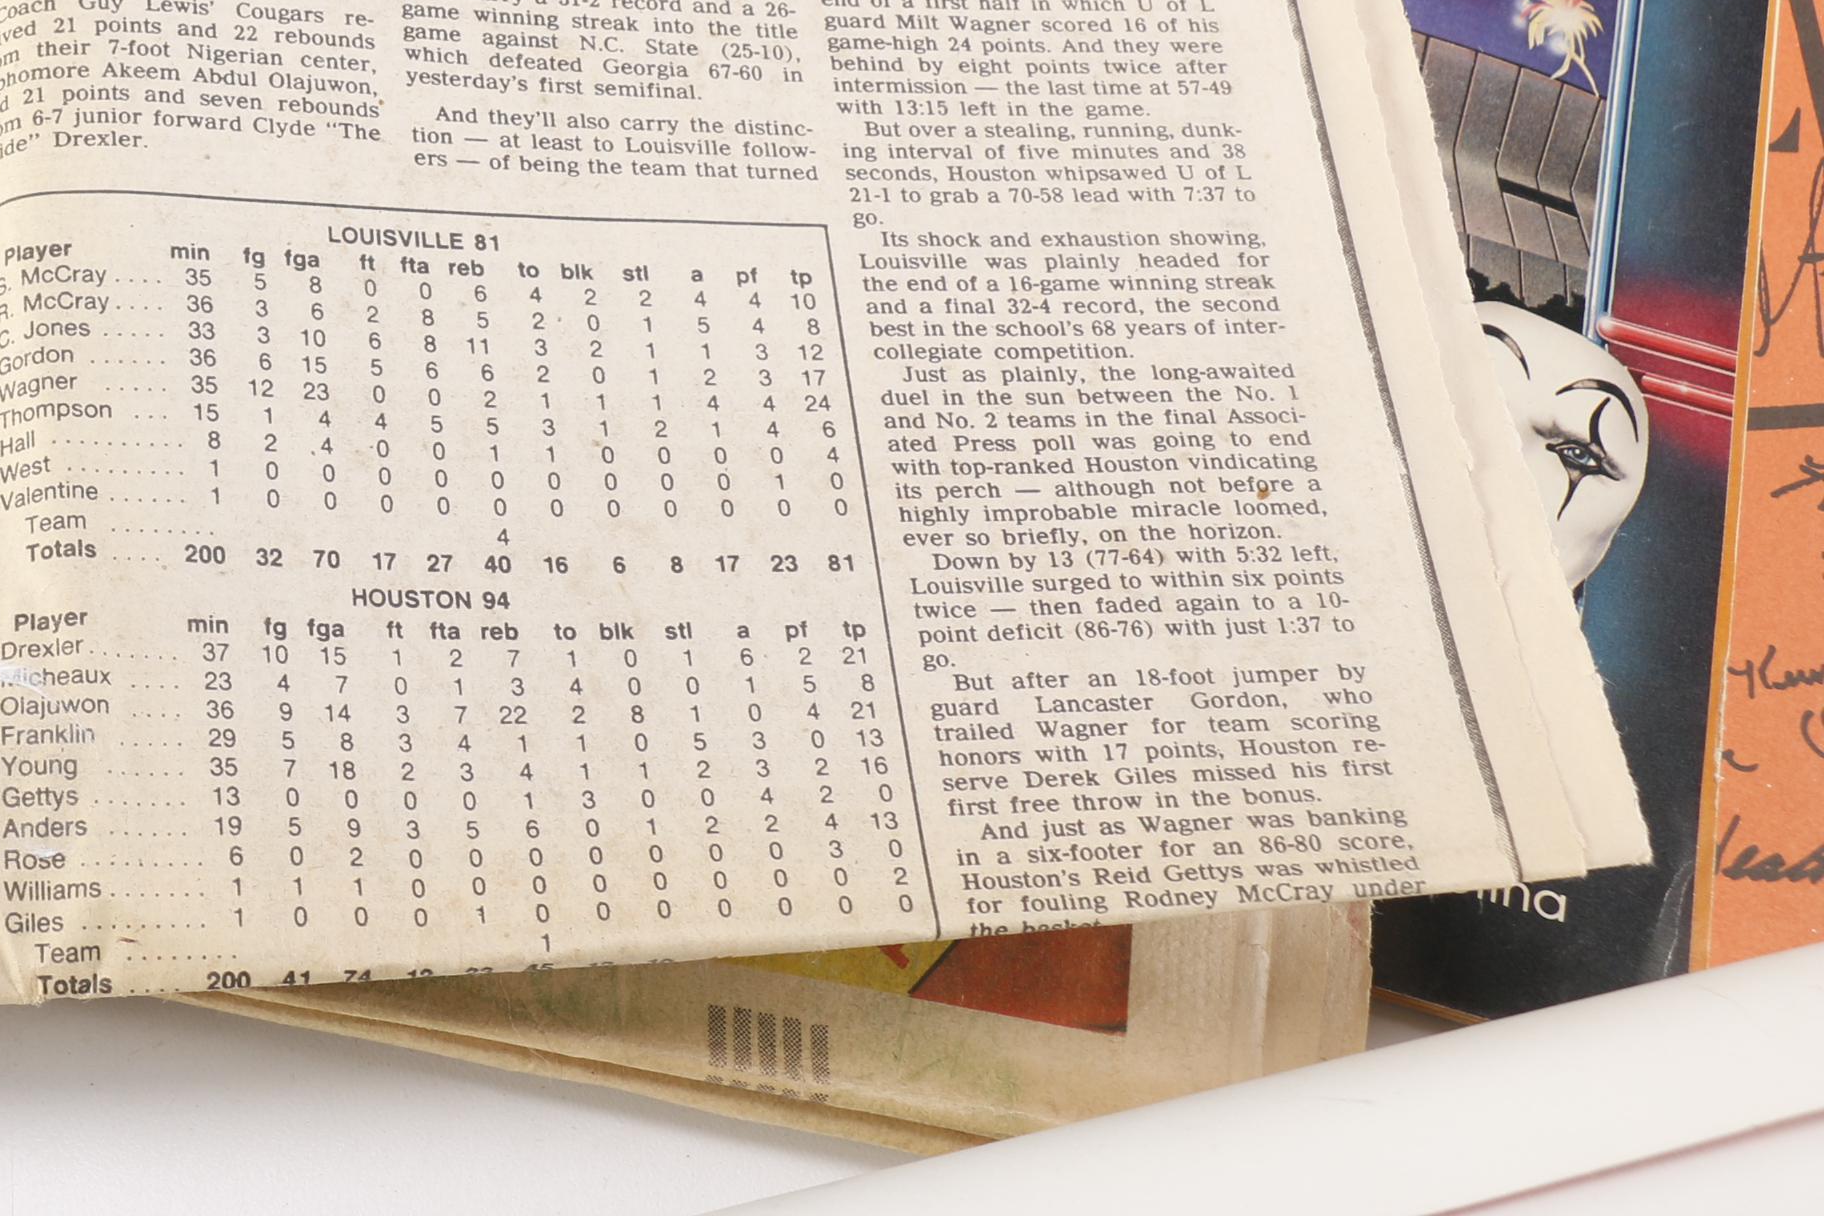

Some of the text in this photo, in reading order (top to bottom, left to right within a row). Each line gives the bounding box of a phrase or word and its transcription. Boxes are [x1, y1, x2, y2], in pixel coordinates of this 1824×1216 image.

[235, 1, 325, 25] Cougars
[344, 13, 375, 27] re-
[538, 76, 584, 96] first
[593, 81, 702, 101] semifinal.
[52, 130, 148, 149] Drexler.
[327, 225, 499, 252] LOUISVILLE 81
[4, 242, 813, 290] Player min fg fga ft fta reb to blk stl a pf tp
[858, 251, 1270, 274] Louisville was plainly headed for
[21, 264, 107, 288] McCray
[23, 290, 110, 315] McCray
[23, 320, 92, 340] Jones
[873, 342, 1134, 364] collegiate competition.
[0, 429, 36, 458] Hall
[0, 455, 51, 484] West
[0, 480, 99, 511] Valentine
[24, 514, 87, 534] Team
[25, 538, 855, 573] Totals 200 81
[351, 587, 511, 610] HOUSTON 94
[14, 610, 89, 634] Player
[0, 695, 110, 721] Olajuwon
[930, 687, 1373, 722] guard Lancaster Gordon, who
[0, 723, 96, 751] Franklin
[0, 755, 78, 781] Young
[941, 759, 1394, 792] serve Derek Giles missed his first
[1, 786, 80, 813] Gettys
[2, 816, 88, 840] Anders
[3, 848, 66, 871] Rose
[2, 879, 102, 902] Williams
[966, 878, 1422, 915] for fouling Rodney McCray under
[4, 911, 64, 935] Giles
[34, 942, 102, 965] Team
[35, 970, 254, 996] Totals 200
